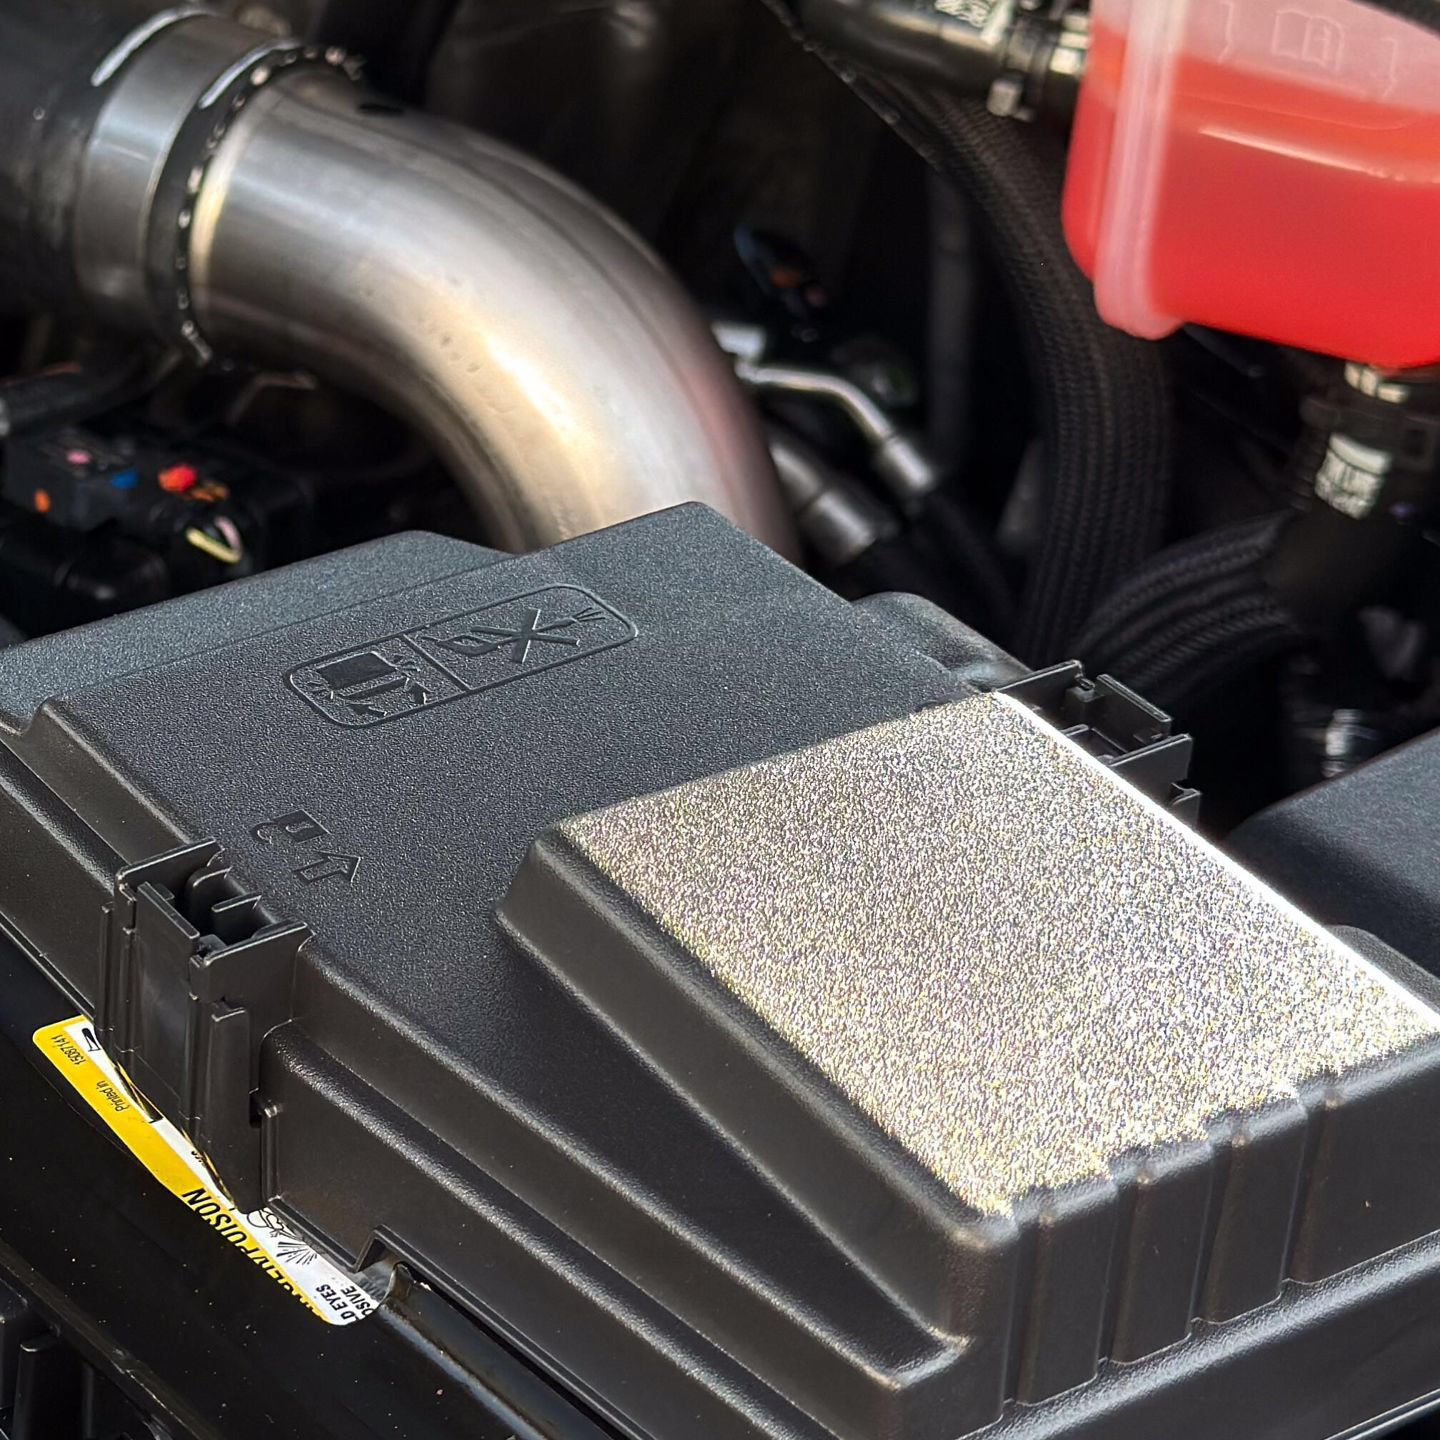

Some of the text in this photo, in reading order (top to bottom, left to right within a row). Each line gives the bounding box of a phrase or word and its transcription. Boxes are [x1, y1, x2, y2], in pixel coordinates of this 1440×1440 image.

[51, 1032, 87, 1067] 15087141
[100, 1087, 129, 1113] Printed
[315, 1282, 348, 1311] EYES
